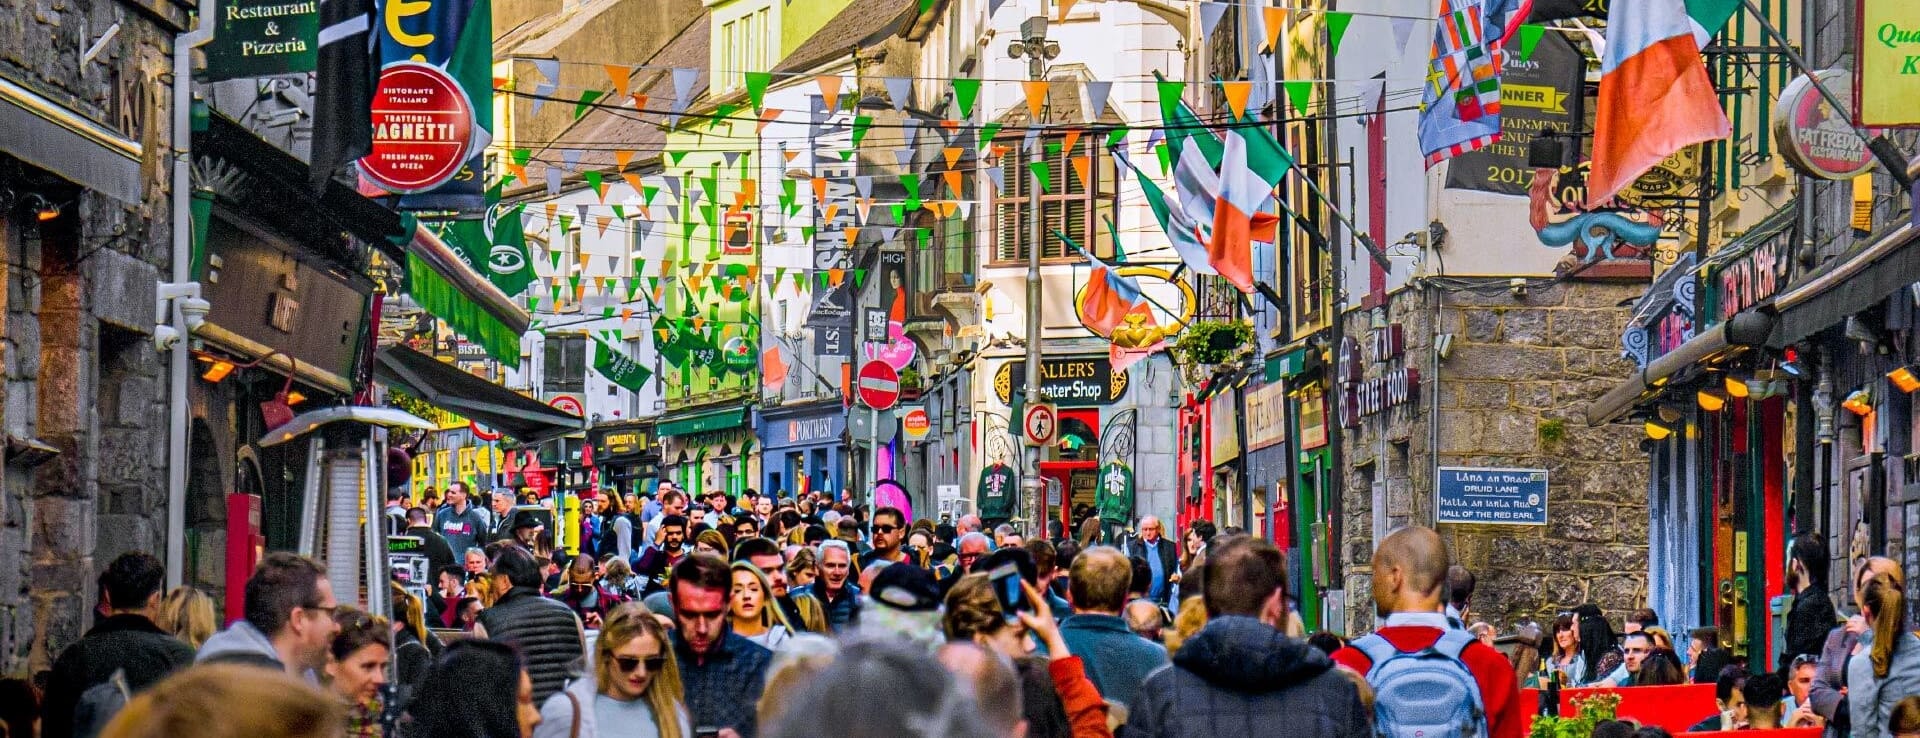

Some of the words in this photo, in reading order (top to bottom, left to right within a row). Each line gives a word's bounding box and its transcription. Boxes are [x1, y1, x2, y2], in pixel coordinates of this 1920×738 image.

[226, 1, 316, 20] Restaurant
[264, 21, 280, 36] &
[242, 37, 307, 56] Pizzeria
[383, 87, 434, 95] RISTORANTE
[1502, 88, 1545, 103] NNER
[389, 96, 429, 104] ITALIANO
[384, 115, 433, 123] TRATTORIA
[371, 123, 455, 140] AGNETTI
[1501, 132, 1533, 144] ENUE
[381, 153, 407, 161] FRESH
[410, 153, 434, 161] PASTA
[1490, 143, 1515, 156] THE
[1810, 145, 1863, 162] RESTAURANT
[1487, 166, 1537, 190] 2017
[458, 345, 488, 355] BISTR
[1041, 362, 1096, 379] ALLER'S
[1073, 380, 1101, 400] Shop
[1357, 378, 1384, 418] STREET
[1387, 367, 1408, 407] FOOD
[795, 417, 833, 441] PORTWEST
[1464, 485, 1492, 493] DRUID
[1495, 486, 1519, 494] LANE
[1462, 510, 1473, 518] OF
